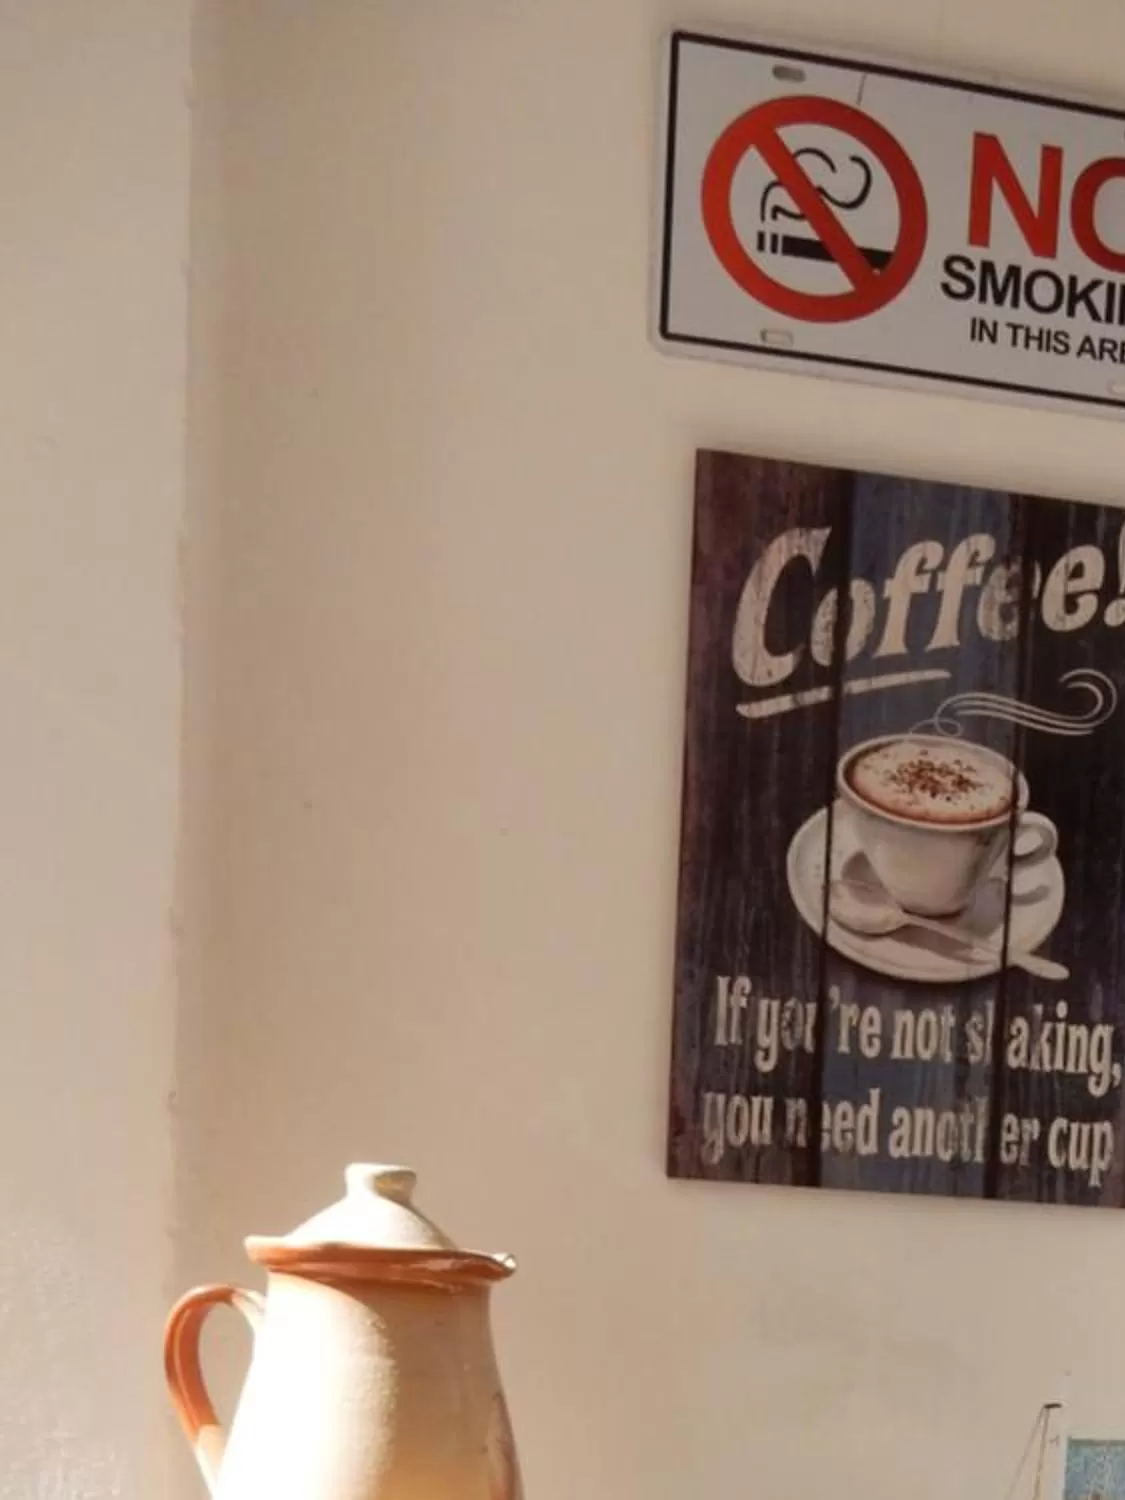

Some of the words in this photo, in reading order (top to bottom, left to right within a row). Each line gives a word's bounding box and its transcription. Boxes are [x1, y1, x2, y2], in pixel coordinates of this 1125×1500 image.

[970, 317, 998, 344] IN
[1005, 322, 1072, 356] THIS
[714, 975, 752, 1046] If
[892, 1003, 957, 1063] not
[702, 1090, 774, 1165] you
[1048, 1116, 1115, 1188] cup
